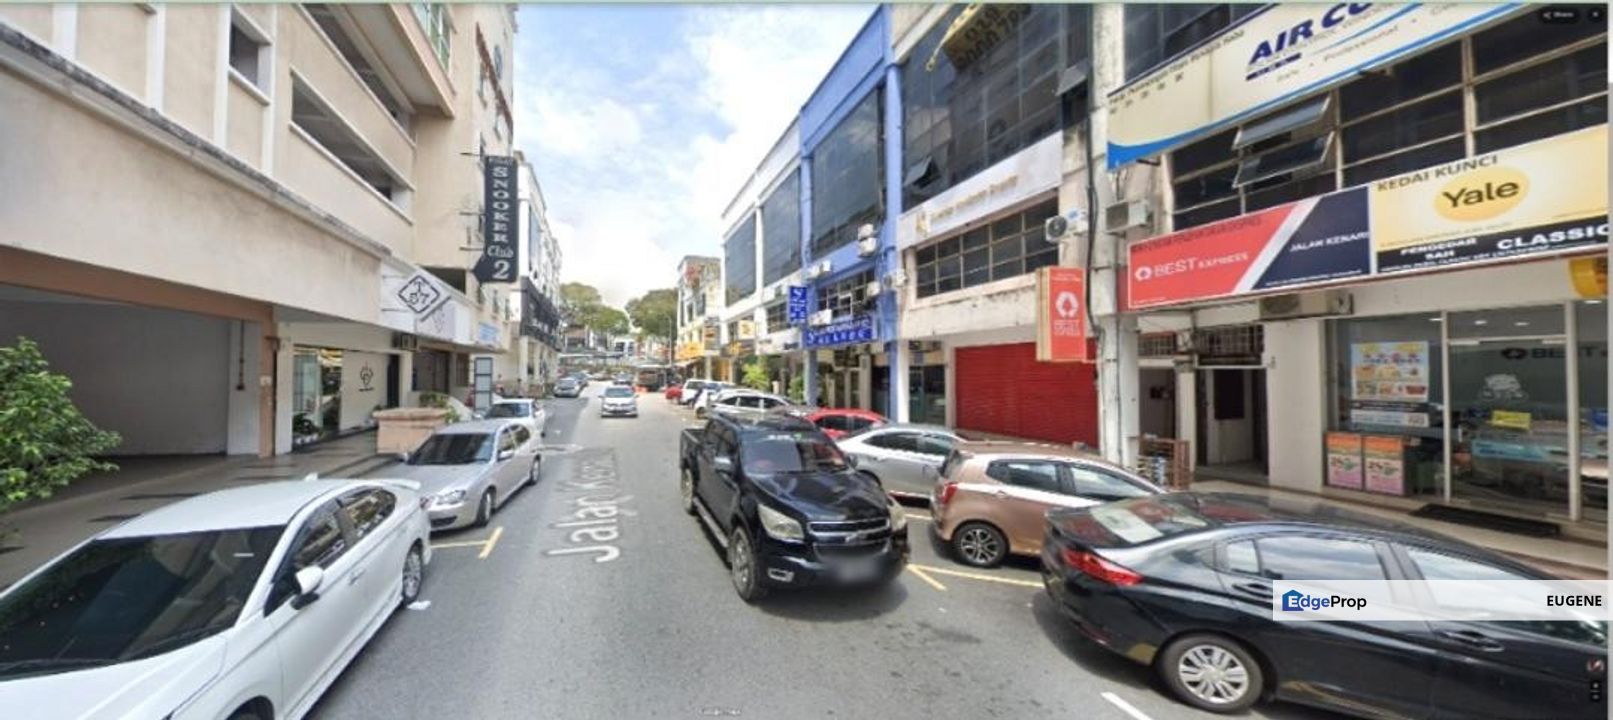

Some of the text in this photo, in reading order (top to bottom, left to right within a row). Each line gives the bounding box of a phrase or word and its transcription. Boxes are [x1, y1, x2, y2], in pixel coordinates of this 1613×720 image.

[1248, 19, 1314, 65] AIR
[1377, 156, 1498, 192] KEDAI KUNCI
[492, 165, 509, 243] SNOOKER
[1442, 182, 1519, 208] Yale
[486, 244, 514, 258] Club
[1290, 239, 1324, 252] JALAN
[492, 260, 511, 279] 2
[1154, 257, 1198, 277] BEST
[543, 496, 620, 563] Jalan
